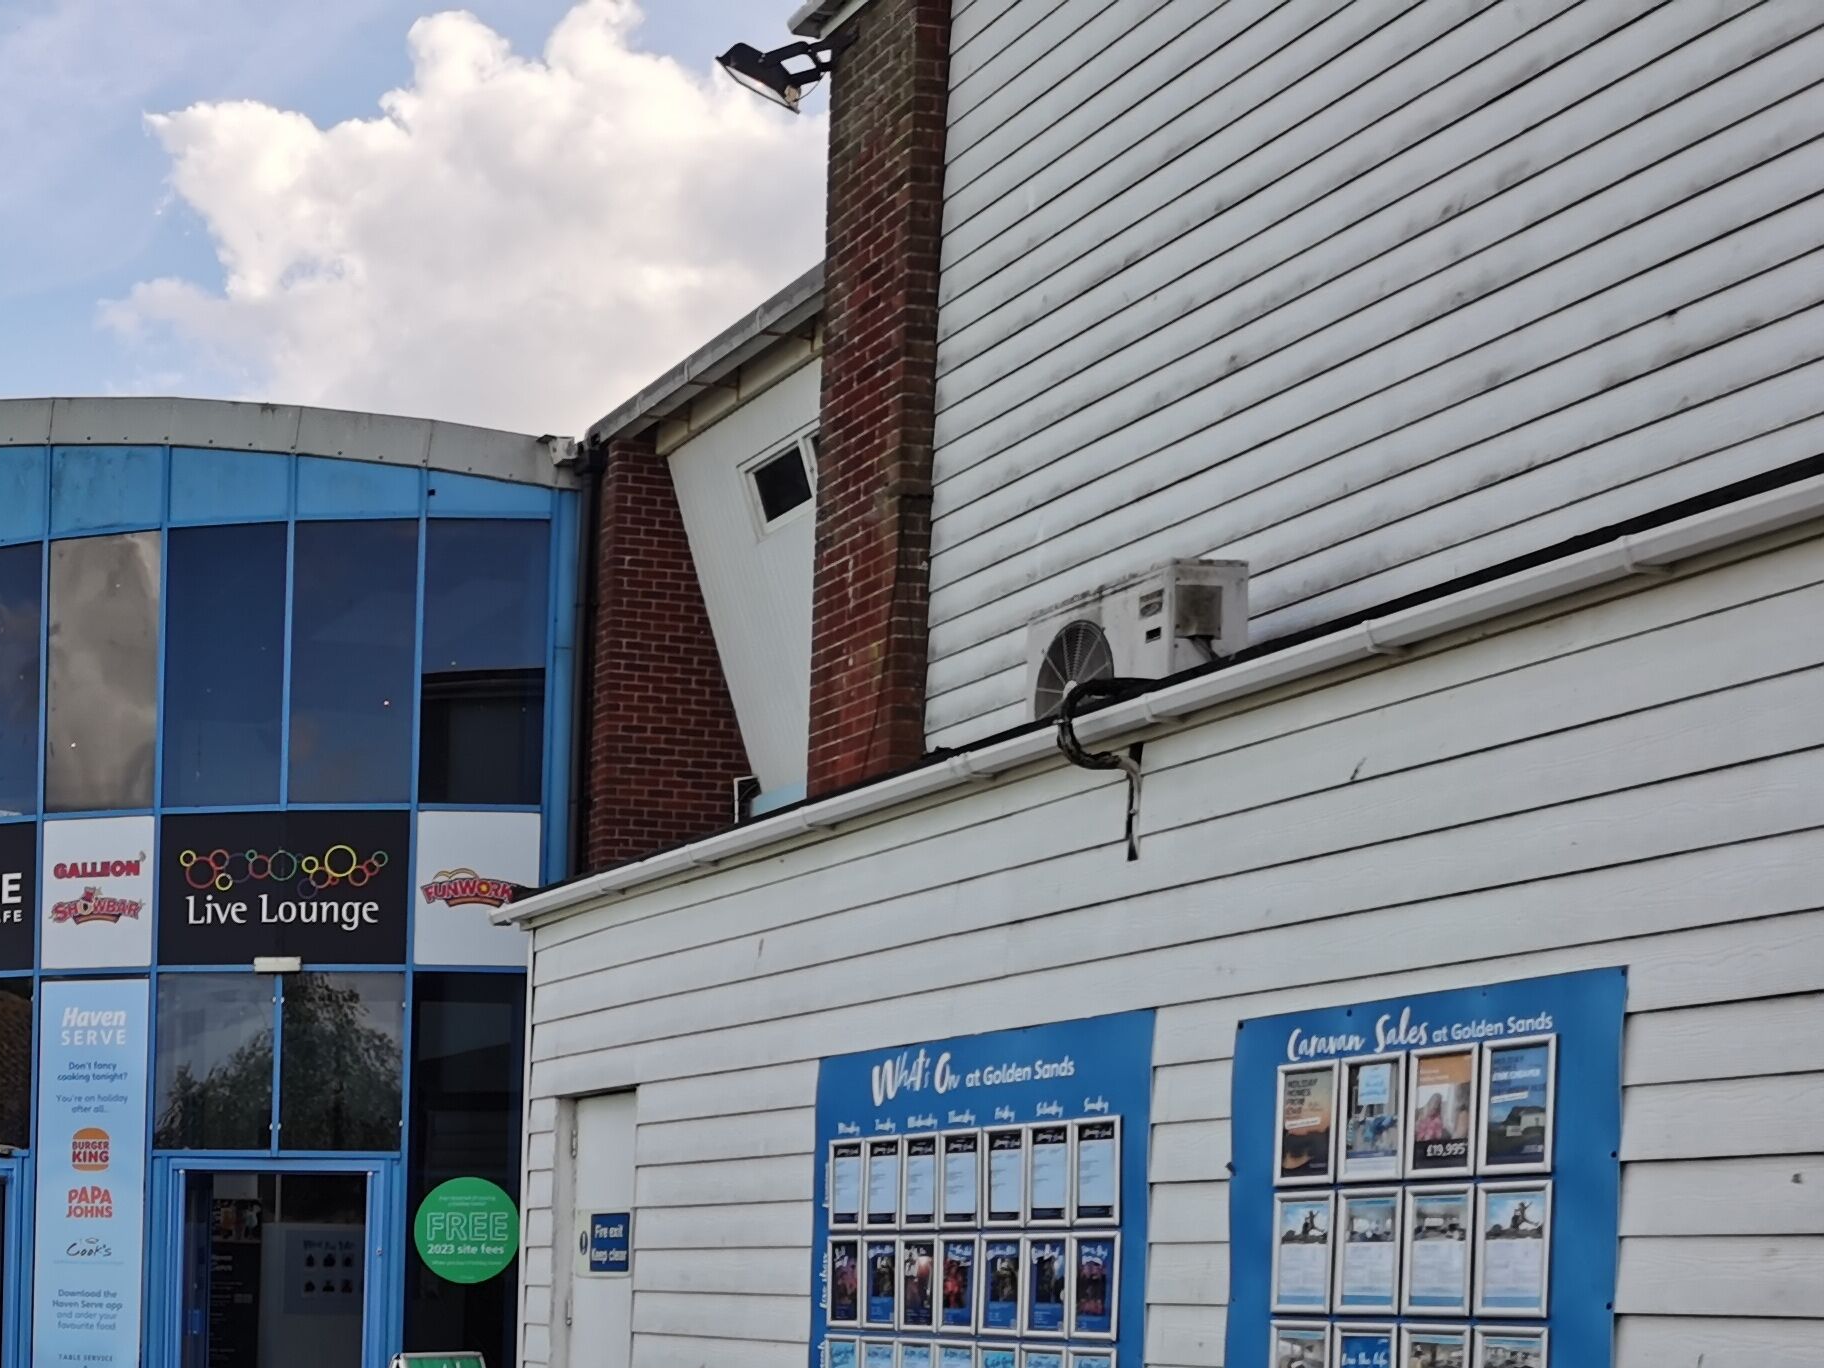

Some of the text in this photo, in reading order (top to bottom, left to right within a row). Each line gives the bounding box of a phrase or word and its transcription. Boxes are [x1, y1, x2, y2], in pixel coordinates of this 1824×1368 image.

[422, 877, 514, 903] FUNWORK
[185, 893, 380, 931] Live Lounge
[62, 1006, 127, 1028] Haven
[61, 1029, 126, 1046] SERVE
[1287, 1006, 1553, 1061] Caravan Sales at Golden Sands
[965, 1070, 981, 1088] at
[983, 1062, 1032, 1086] Golden
[1034, 1055, 1075, 1080] Sands
[72, 1141, 109, 1150] BURGER
[72, 1151, 109, 1163] KING
[67, 1185, 112, 1204] PAPA
[65, 1205, 113, 1218] JOHNS
[426, 1212, 509, 1241] FREE
[427, 1243, 505, 1255] 2023 site fees
